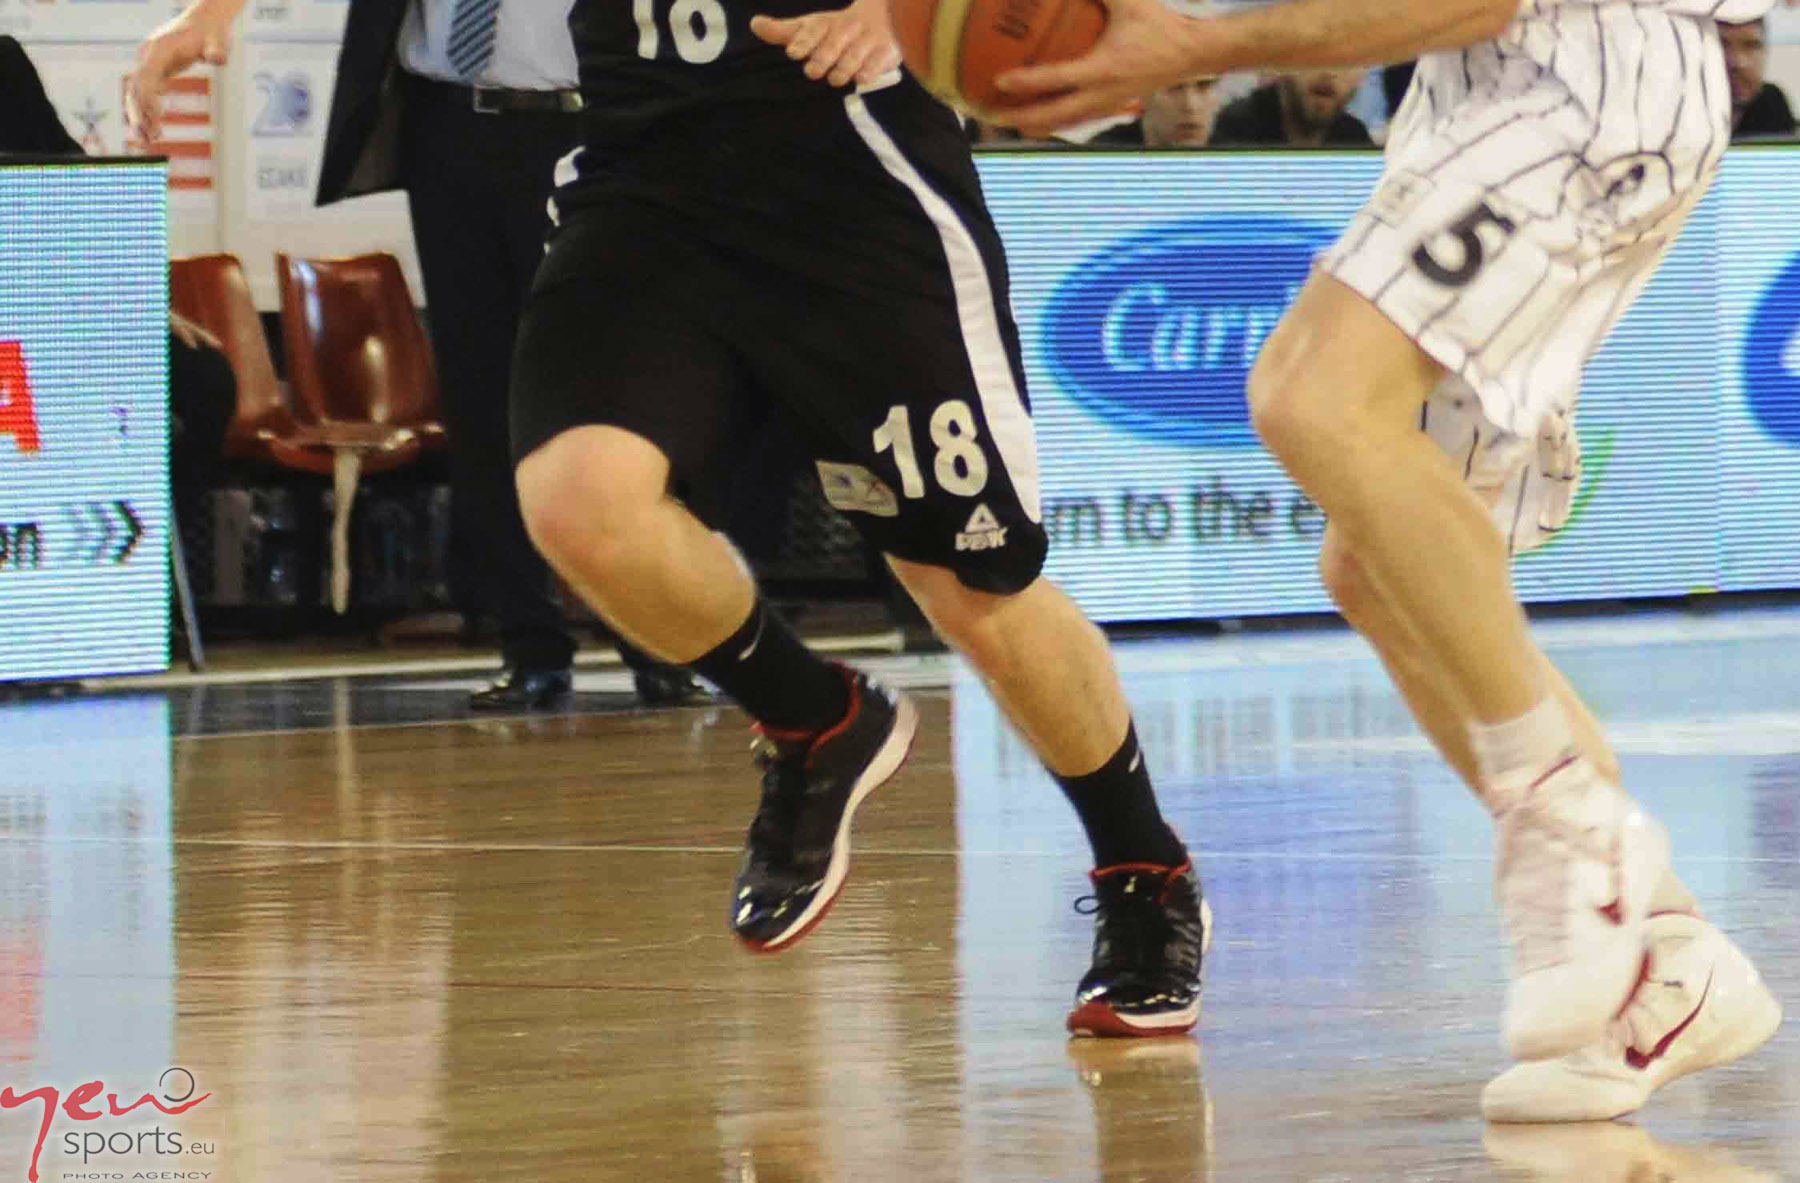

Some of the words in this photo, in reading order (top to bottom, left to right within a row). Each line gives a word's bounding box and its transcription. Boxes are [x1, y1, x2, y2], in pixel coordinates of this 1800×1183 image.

[1411, 202, 1517, 288] 5
[872, 399, 988, 499] 18
[1121, 487, 1173, 545] to
[1193, 476, 1272, 541] the
